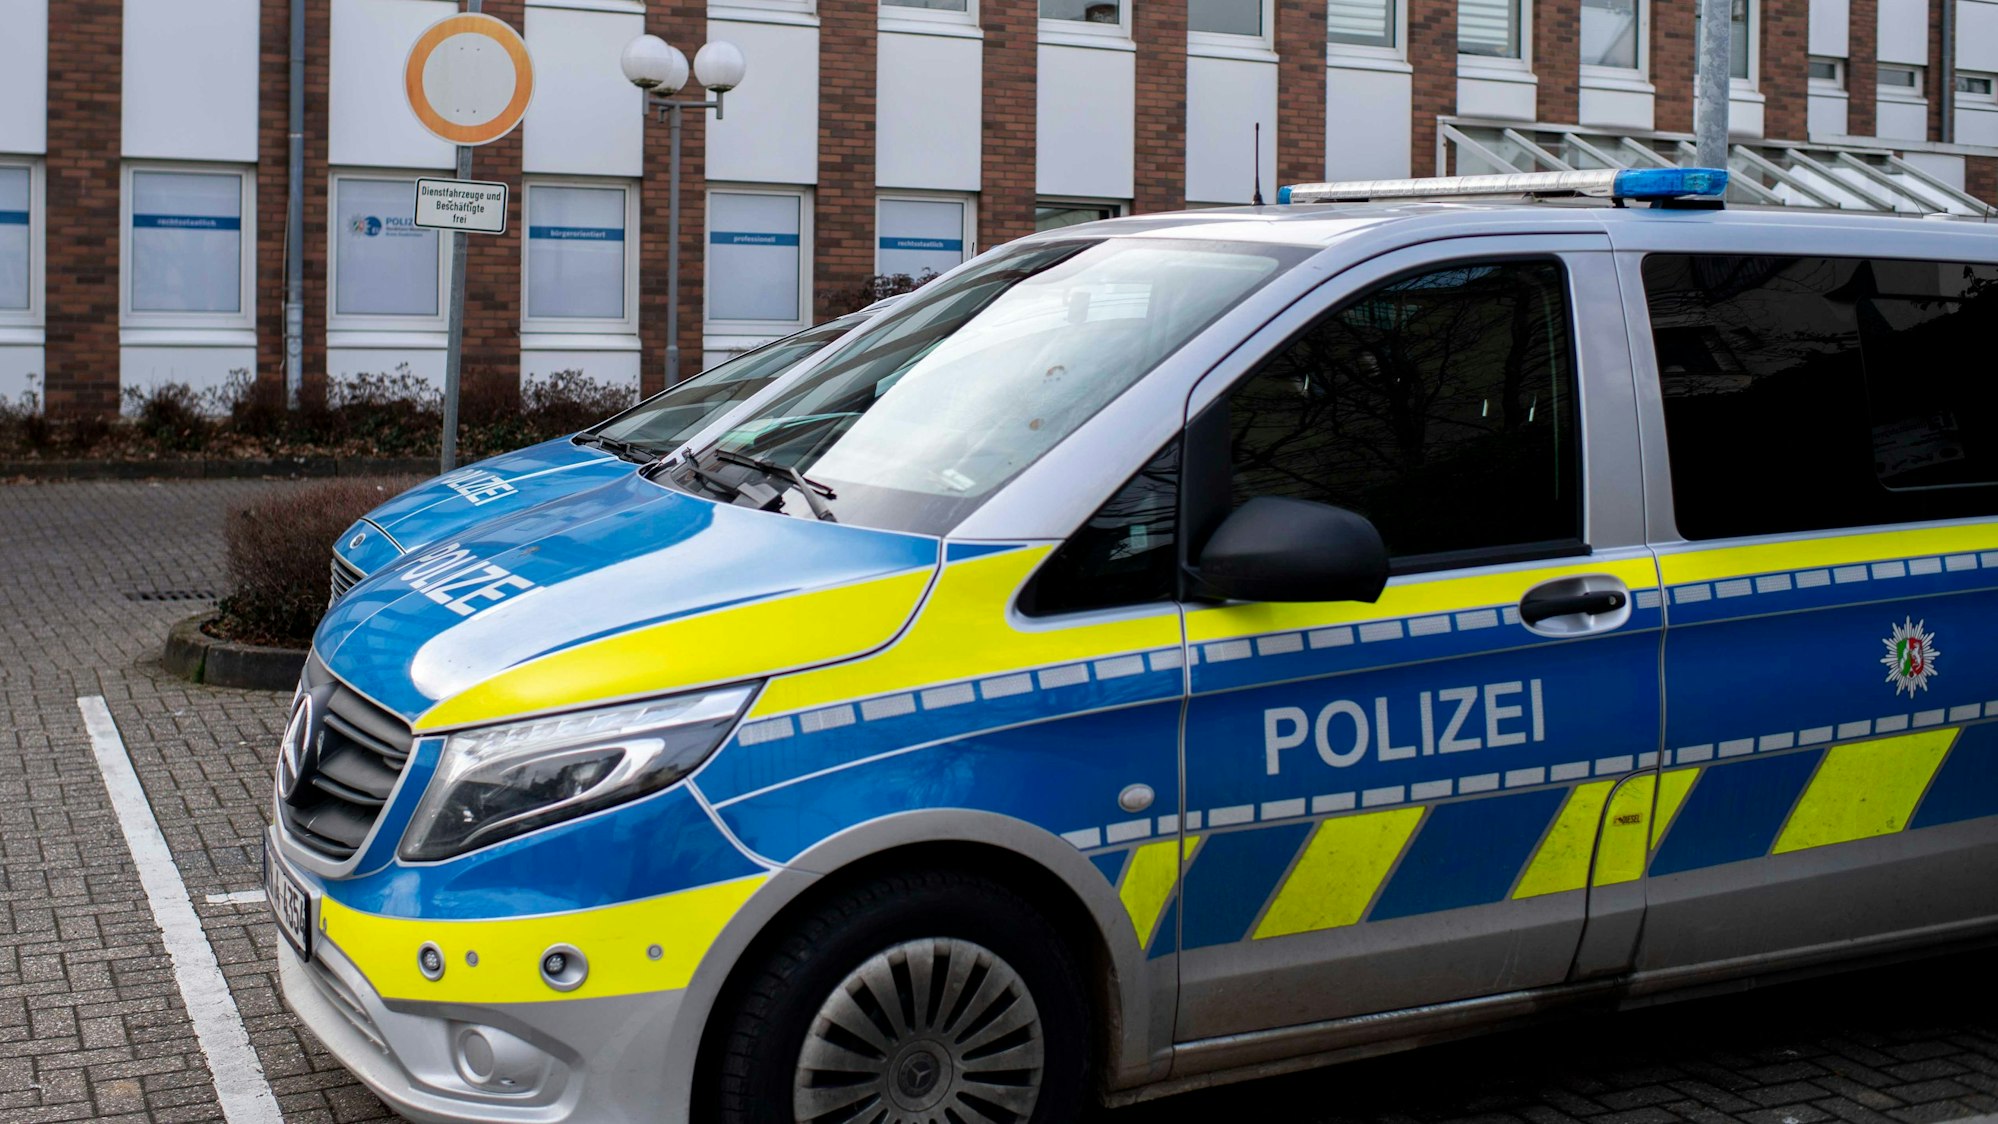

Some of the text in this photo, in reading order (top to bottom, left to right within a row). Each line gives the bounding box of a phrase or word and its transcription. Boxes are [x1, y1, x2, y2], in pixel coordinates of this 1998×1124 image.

[421, 186, 501, 202] Dienstfahrzeuge und
[436, 200, 484, 215] Beschäftigte
[385, 217, 414, 226] POLIZ
[453, 214, 467, 223] frei
[550, 229, 606, 239] bürgerorientiert
[733, 235, 776, 243] professionell
[897, 240, 944, 249] rechtsstaatlich
[395, 542, 546, 621] POLIZEI
[1264, 678, 1545, 776] POLIZEI
